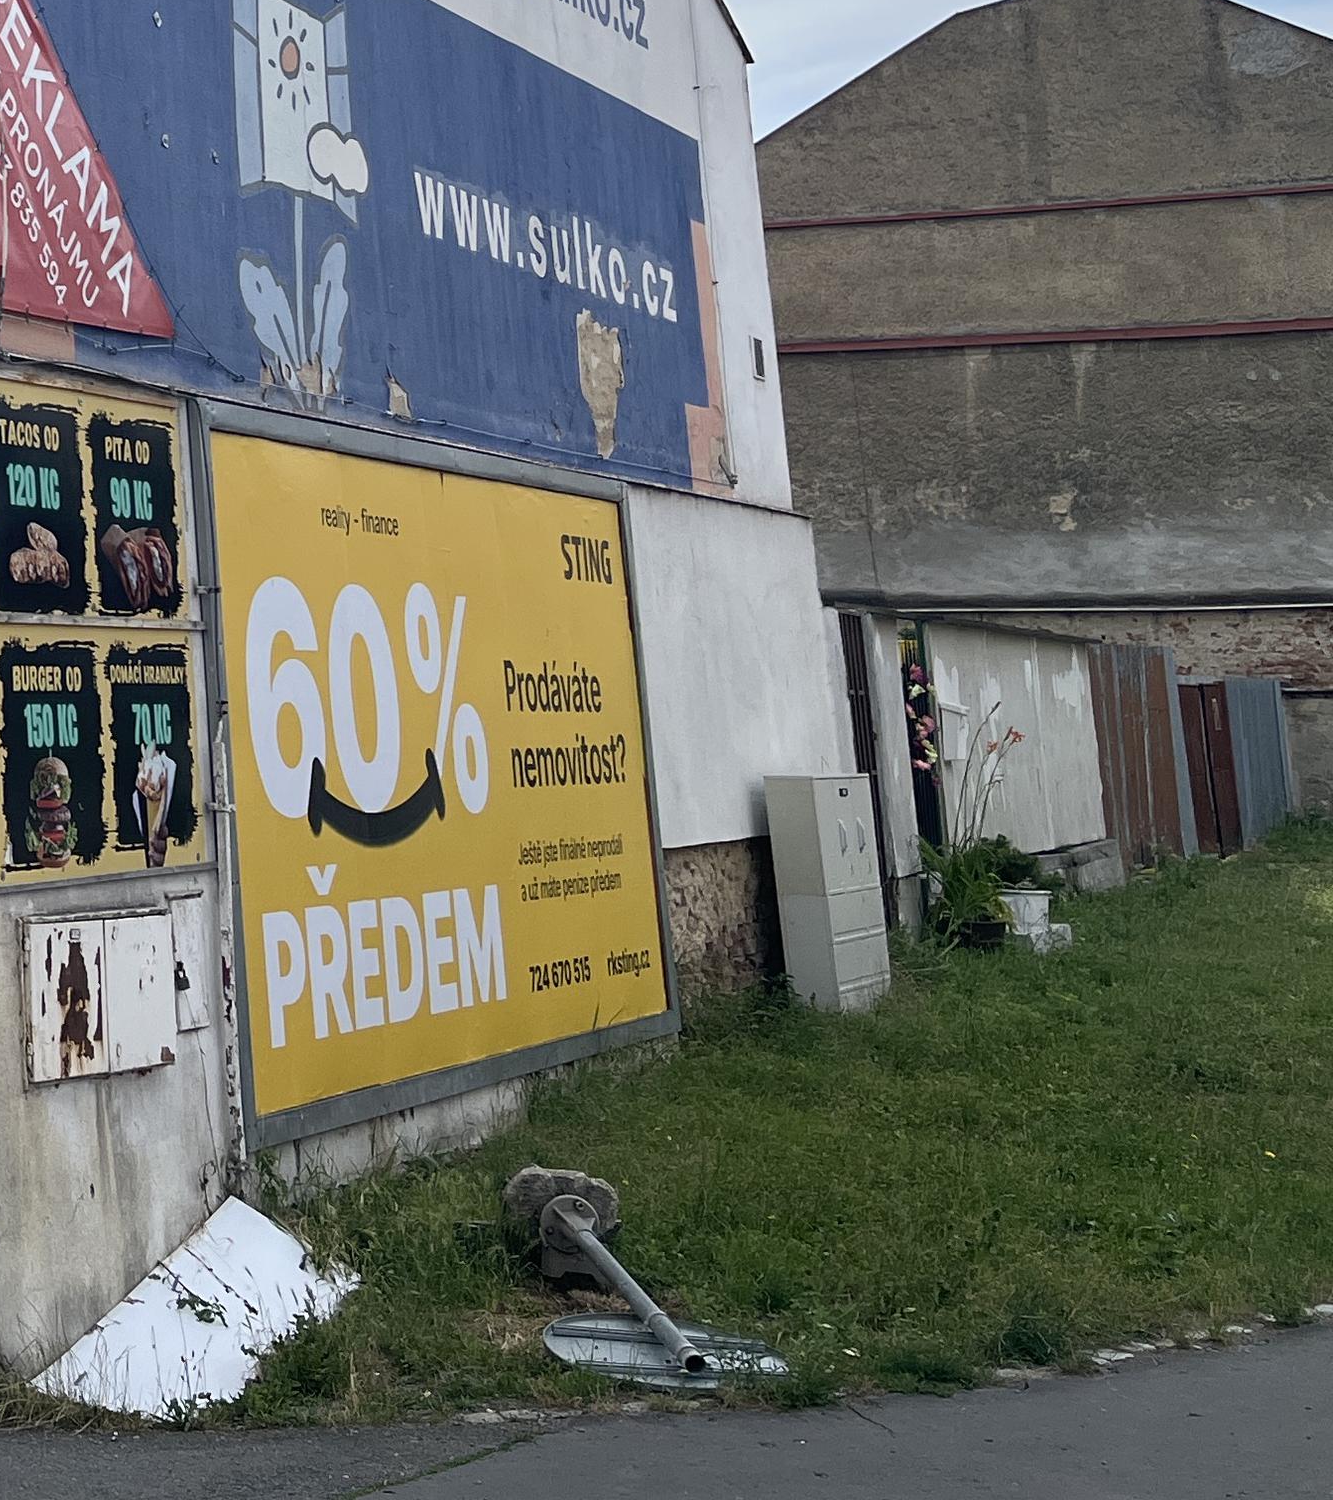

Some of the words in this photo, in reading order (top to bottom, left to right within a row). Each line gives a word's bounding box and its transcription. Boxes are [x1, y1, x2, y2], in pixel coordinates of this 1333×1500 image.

[9, 180, 42, 243] 835
[37, 245, 68, 307] 594
[413, 169, 679, 325] www.sulko.cz
[43, 425, 61, 452] OD
[104, 435, 133, 464] PITA
[135, 439, 151, 466] OD
[5, 462, 36, 508] 120
[109, 476, 131, 520] 90
[361, 507, 400, 536] finance
[560, 533, 614, 585] STING
[11, 664, 63, 694] BURGER
[65, 665, 82, 693] OD
[109, 658, 143, 685] DOMÁCÍ
[503, 659, 602, 714] Prodáváte
[244, 574, 489, 819] 60%
[23, 703, 55, 748] 150
[131, 703, 152, 746] 70
[510, 733, 627, 788] nemovitost?
[520, 883, 527, 902] a
[261, 862, 508, 1050] PŘEDEM
[528, 963, 550, 993] 724
[551, 959, 572, 988] 670
[573, 955, 591, 984] 515
[606, 947, 651, 978] rksting.cz
